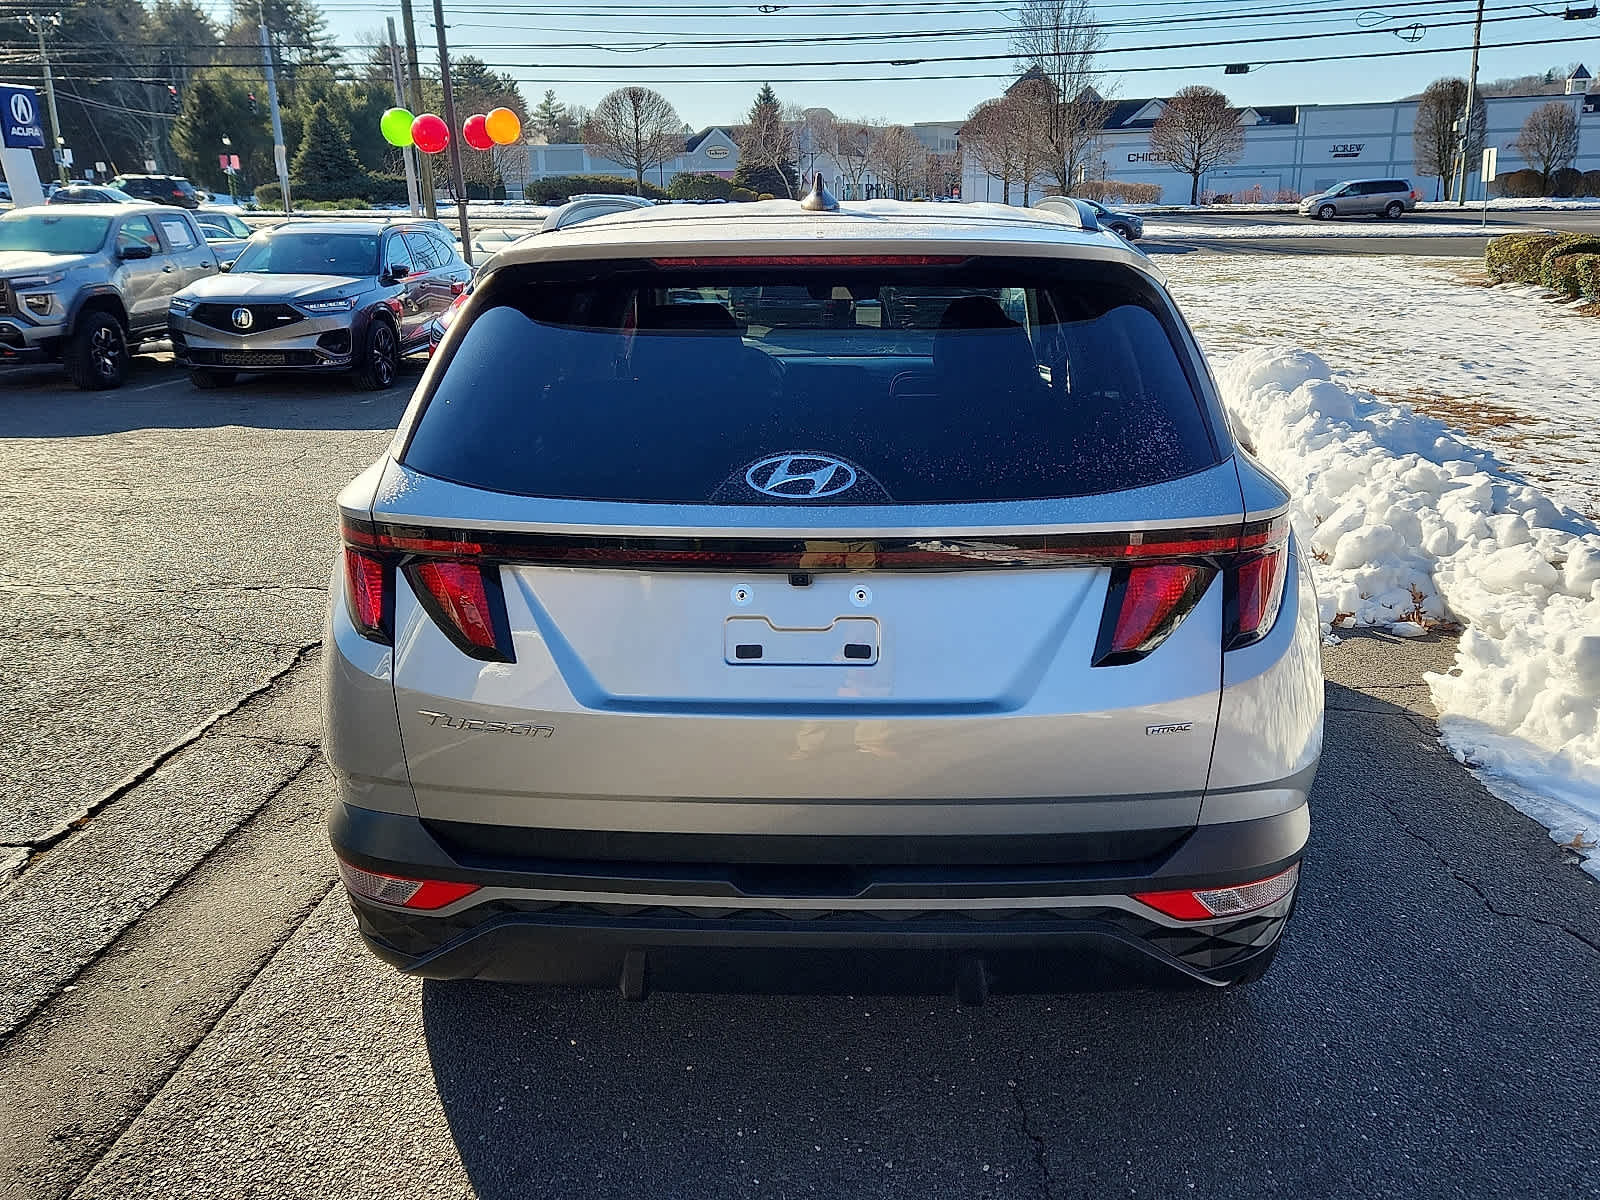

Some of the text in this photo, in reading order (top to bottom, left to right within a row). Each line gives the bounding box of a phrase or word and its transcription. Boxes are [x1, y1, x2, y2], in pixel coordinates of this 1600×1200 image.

[11, 126, 40, 136] ACURA
[417, 709, 555, 739] TUCSON
[1151, 724, 1192, 735] HTRAC
